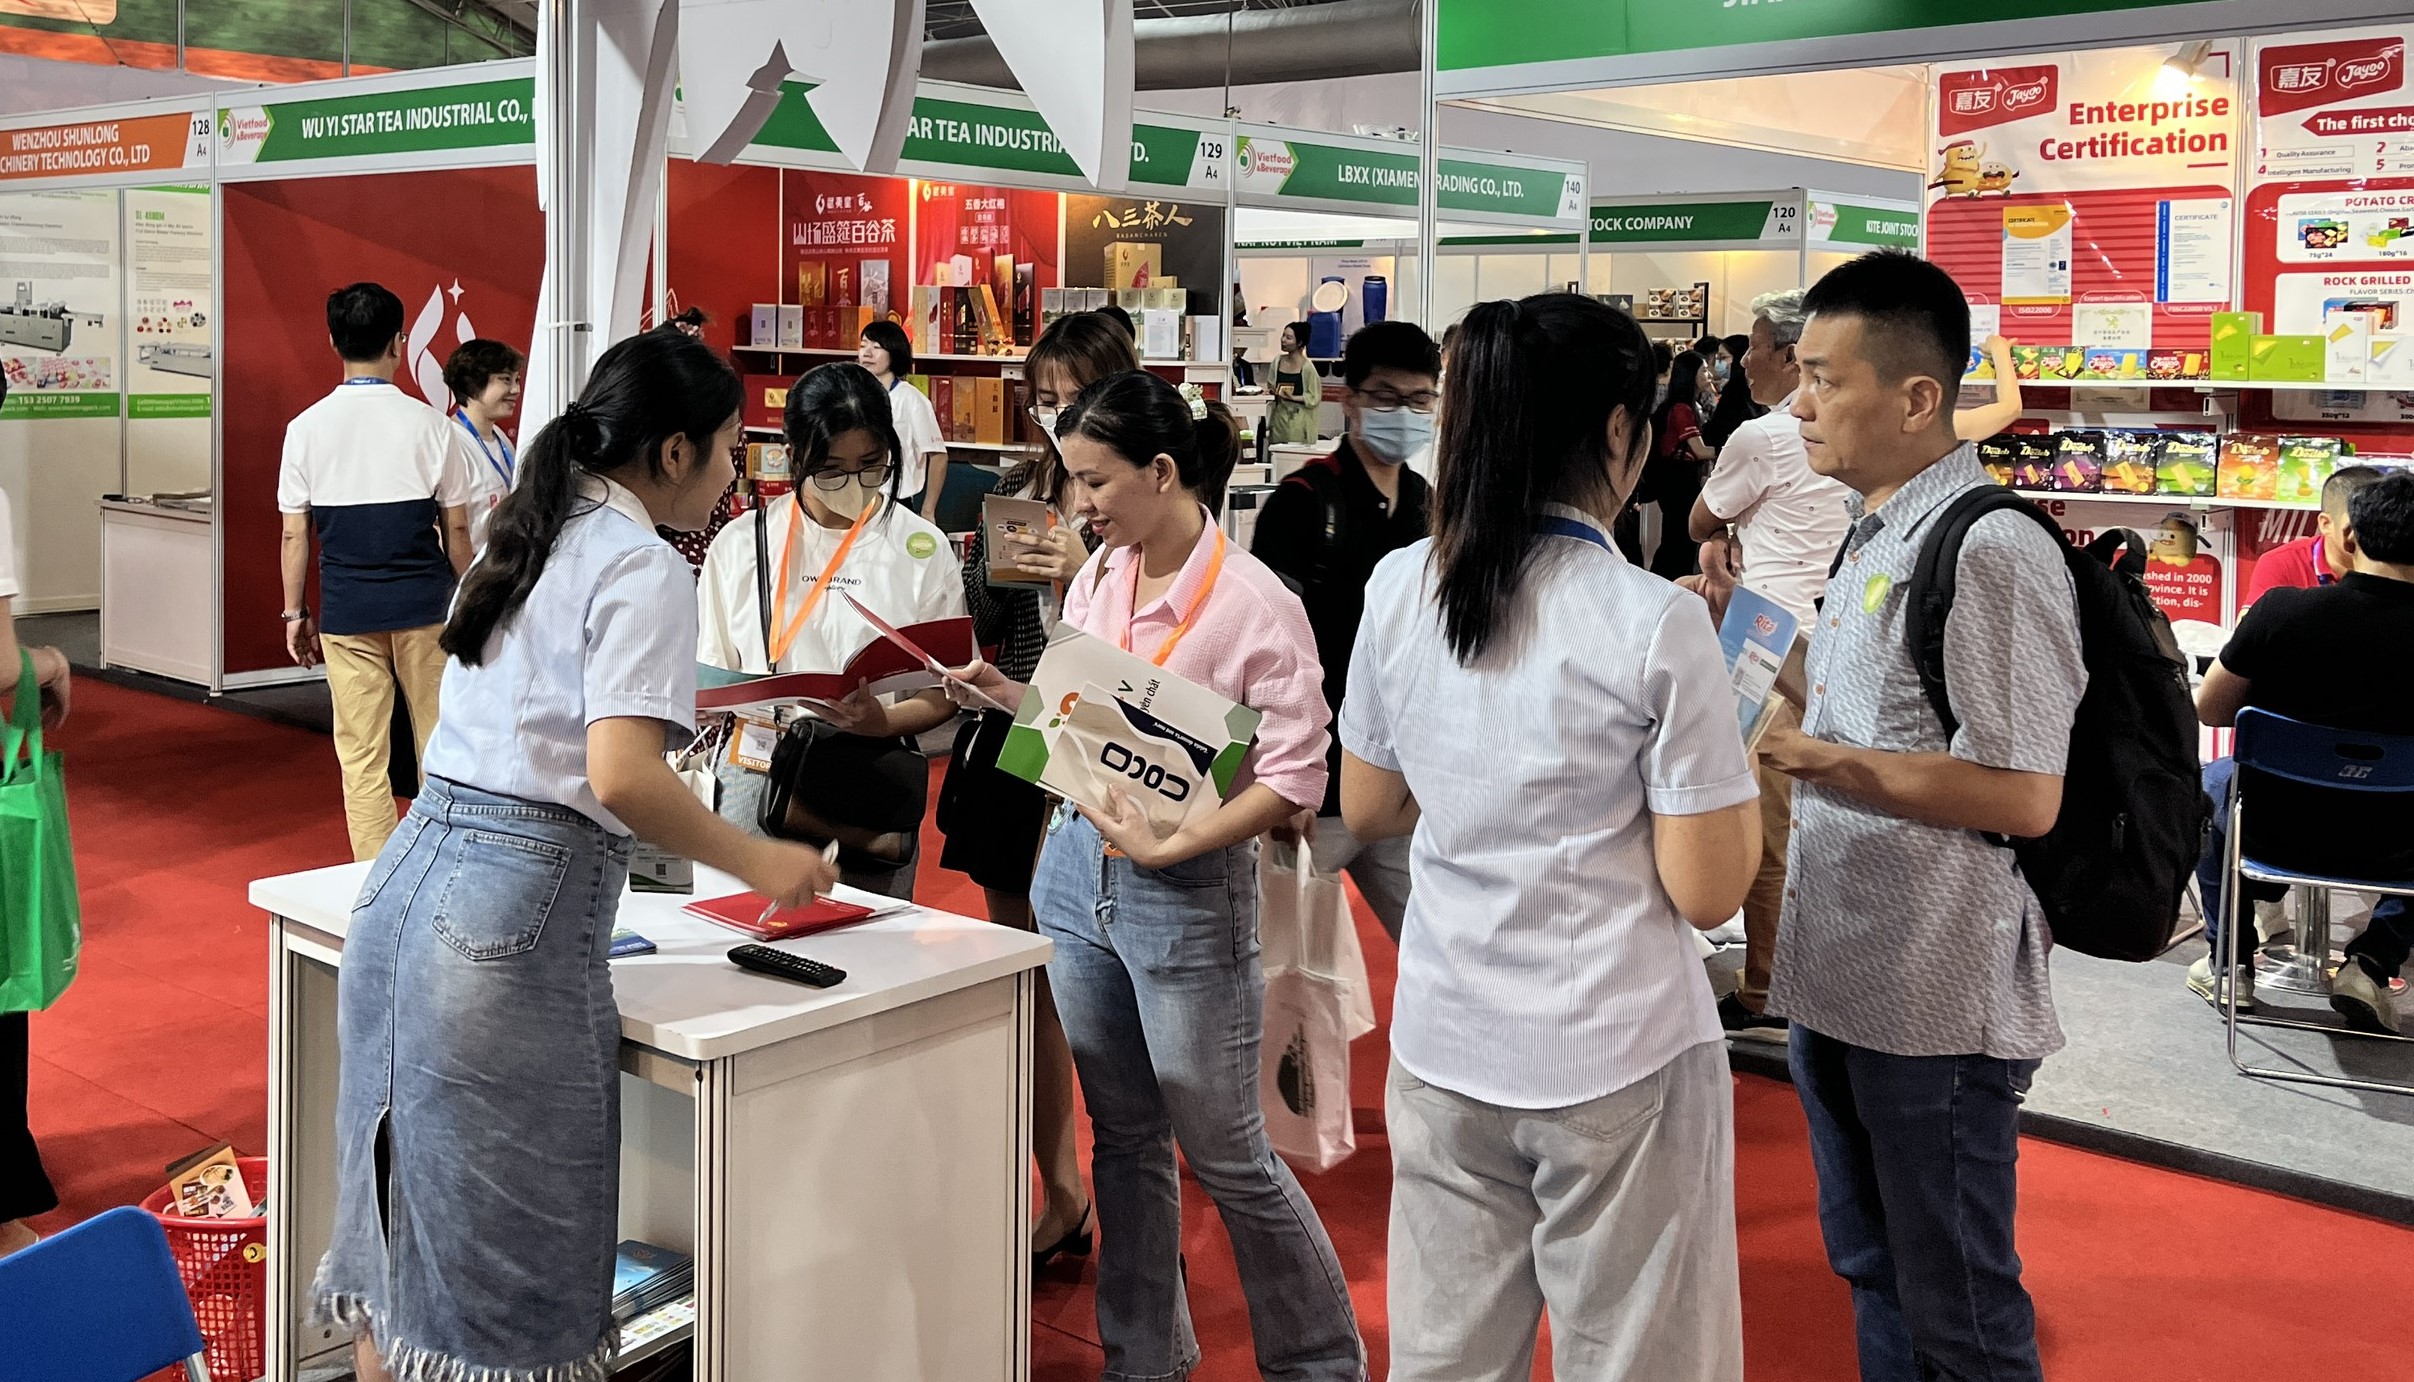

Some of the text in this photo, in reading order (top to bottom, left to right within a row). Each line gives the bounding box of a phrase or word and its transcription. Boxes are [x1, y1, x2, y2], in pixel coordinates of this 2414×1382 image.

[2278, 66, 2323, 89] 嘉友
[2340, 61, 2385, 83] Jayoo
[1955, 90, 1991, 111] 嘉友
[2006, 86, 2042, 106] Jayoo
[2069, 92, 2229, 126] Enterprise
[237, 118, 268, 130] Vietfood
[302, 117, 325, 139] WU
[326, 116, 339, 137] YI
[341, 112, 376, 136] STAR
[377, 108, 403, 133] TEA
[405, 101, 495, 131] INDUSTRIAL
[497, 98, 528, 125] CO.,
[2317, 117, 2347, 131] The
[2351, 115, 2385, 129] first
[192, 119, 210, 136] 128
[12, 124, 119, 151] WENZHOU SHUNLONG
[906, 116, 933, 141] AR
[935, 120, 972, 144] TEA
[975, 125, 1070, 156] INDUSTRI
[2039, 127, 2227, 161] Certification
[1200, 141, 1222, 160] 129
[2260, 148, 2267, 158] 1
[2376, 142, 2386, 153] 2
[41, 148, 107, 171] TECHNOLOGY
[109, 147, 129, 167] CO.,
[130, 144, 150, 164] LTD
[1257, 151, 1292, 165] Vietfood
[2376, 159, 2385, 170] 5
[1205, 165, 1218, 179] A4
[2258, 165, 2266, 174] 4
[1338, 164, 1524, 199] LBXX (XIAMEN RADING CO., LTD.
[1565, 180, 1581, 195] 140
[2346, 197, 2395, 207] POTATO
[1092, 200, 1193, 231] 八三茶人
[1773, 206, 1796, 219] 120
[1589, 216, 1694, 232] TOCK COMPANY
[1778, 223, 1791, 233] A4
[1866, 220, 1919, 237] KITE JOINT STOC
[2323, 275, 2411, 286] ROCK GRILLED
[2174, 572, 2184, 582] in
[2186, 573, 2213, 584] 2000
[2188, 586, 2197, 595] It
[2199, 586, 2208, 596] is
[2183, 597, 2204, 608] dis-
